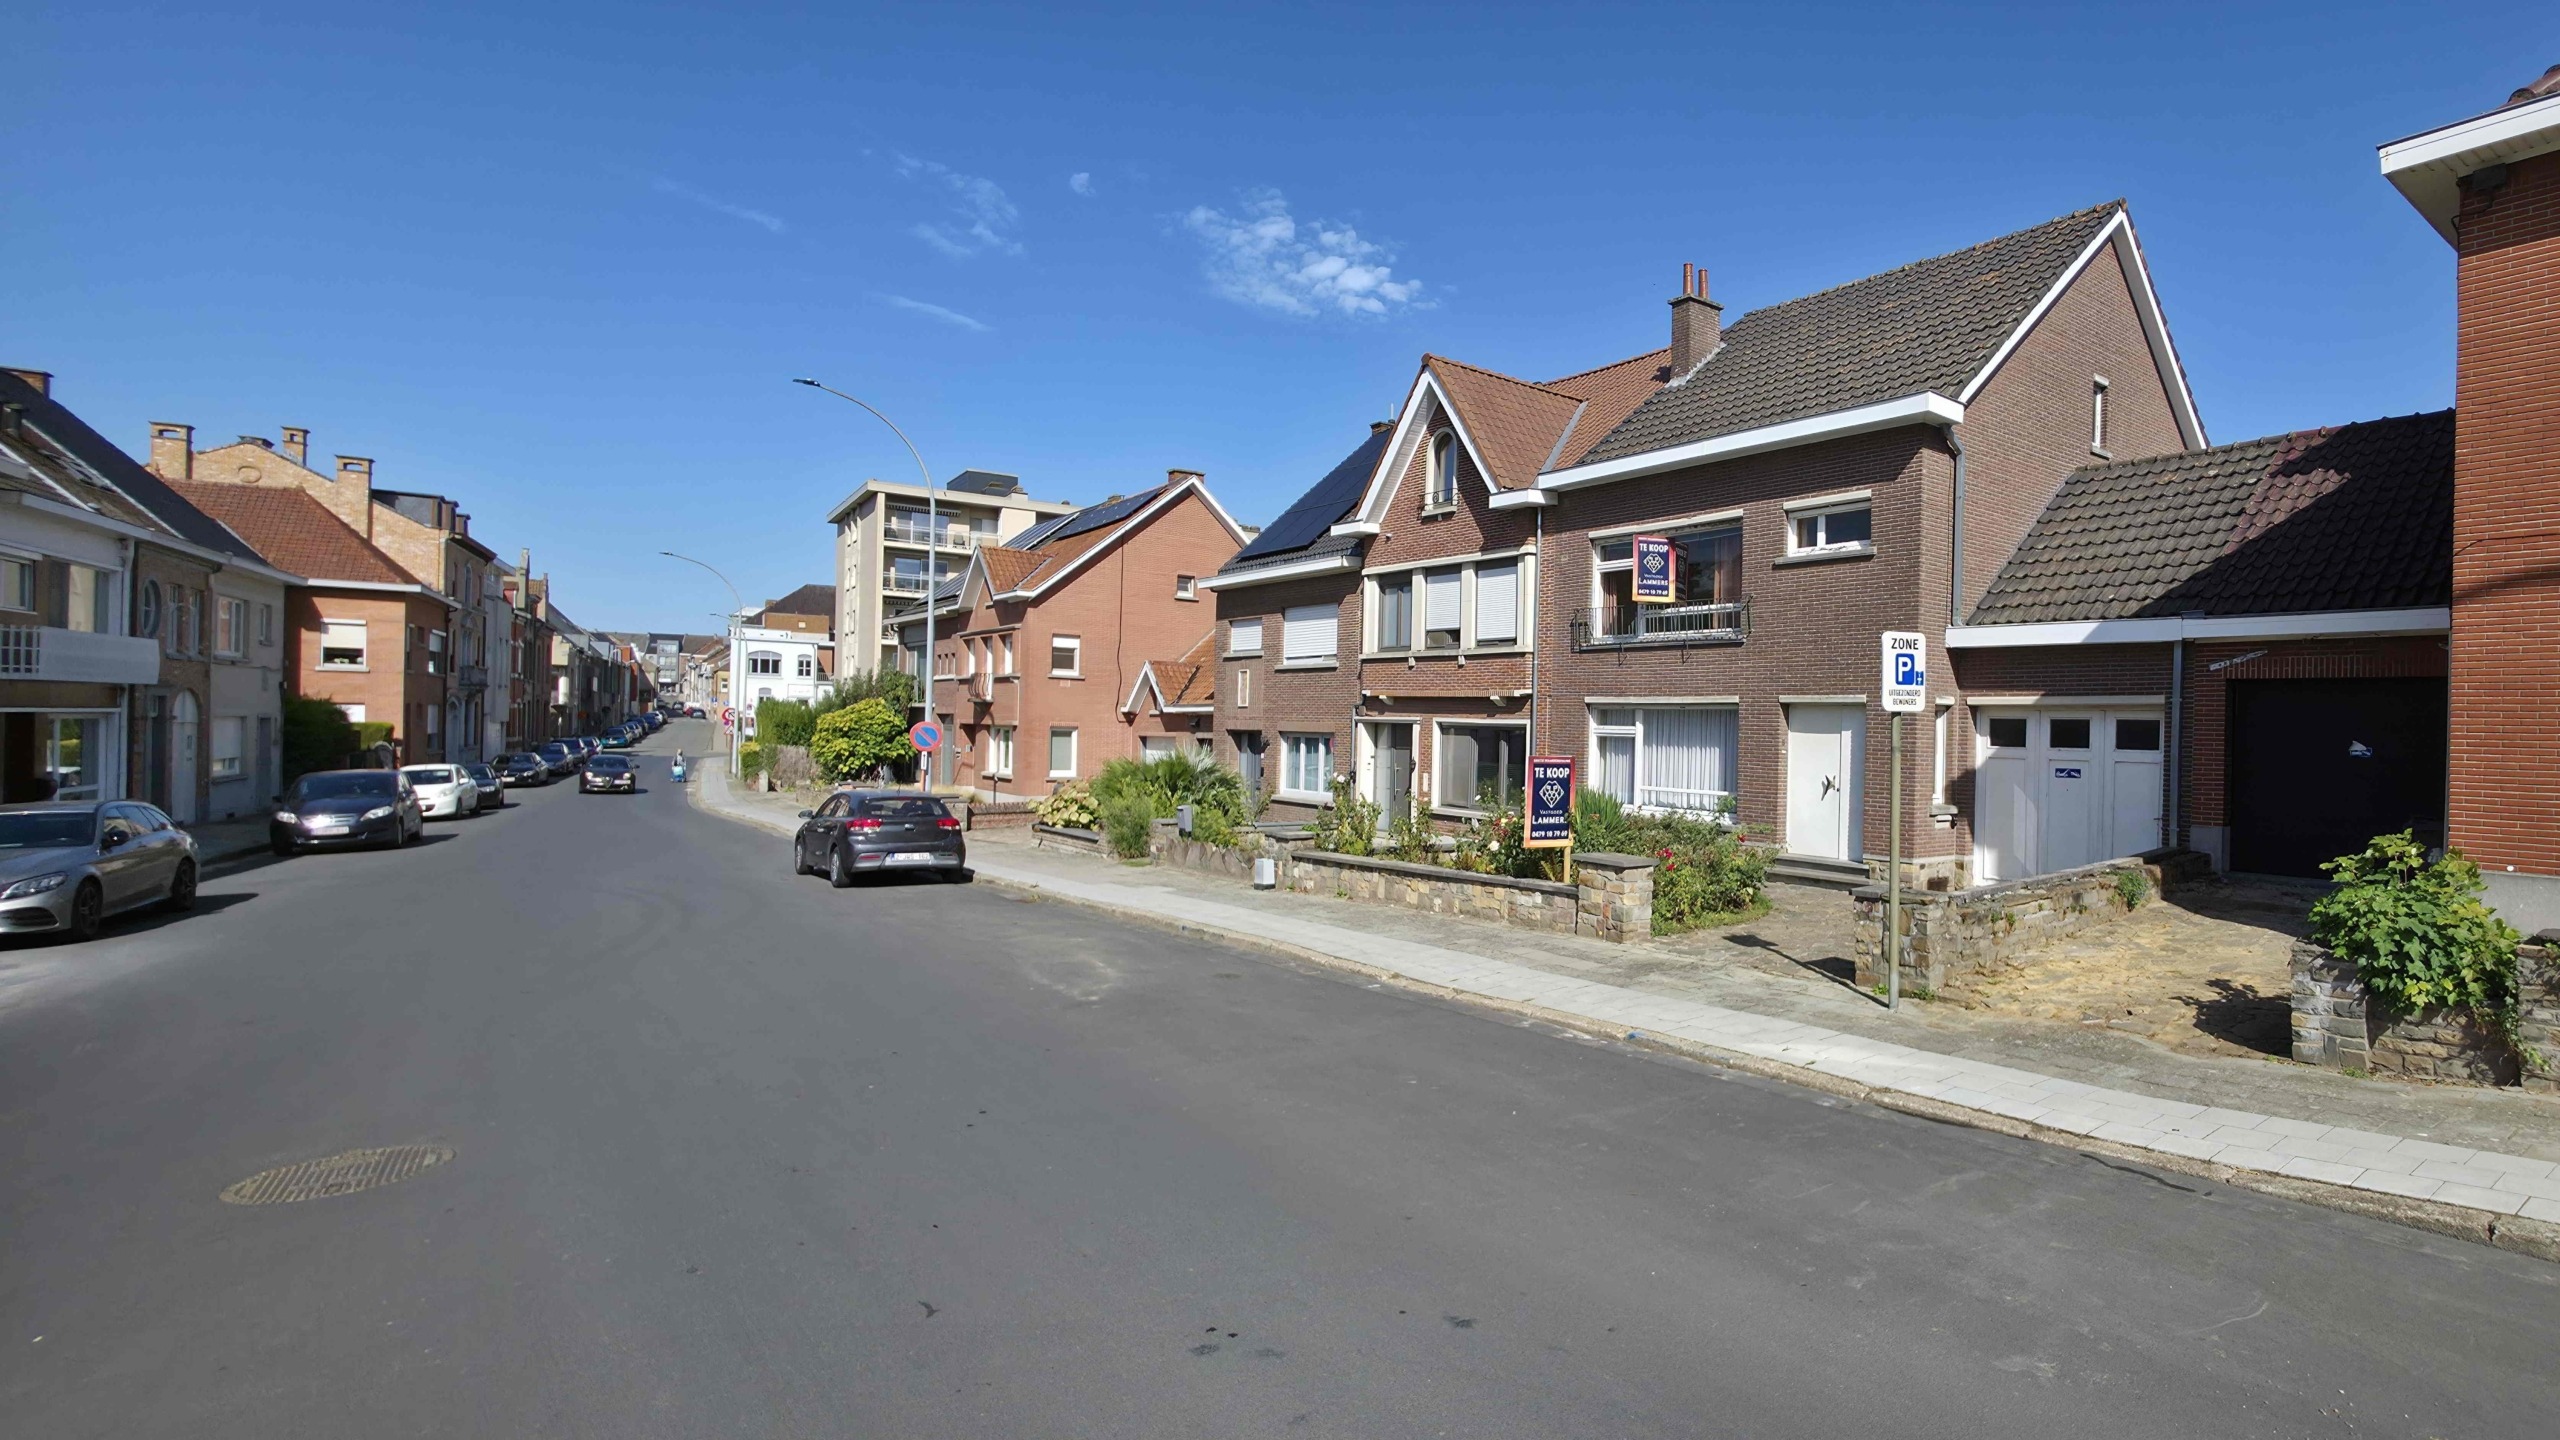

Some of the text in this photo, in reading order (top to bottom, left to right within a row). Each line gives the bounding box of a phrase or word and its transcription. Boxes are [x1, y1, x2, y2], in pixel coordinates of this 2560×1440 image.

[1639, 543, 1648, 551] TE
[1649, 544, 1669, 552] KOOP
[1638, 577, 1668, 585] LAMMERS
[1891, 638, 1919, 650] ZONE
[1898, 656, 1912, 682] P
[1889, 689, 1921, 697] UITGEZONDERD
[1534, 767, 1570, 778] TE KOOP
[1532, 815, 1568, 825] LAMMER
